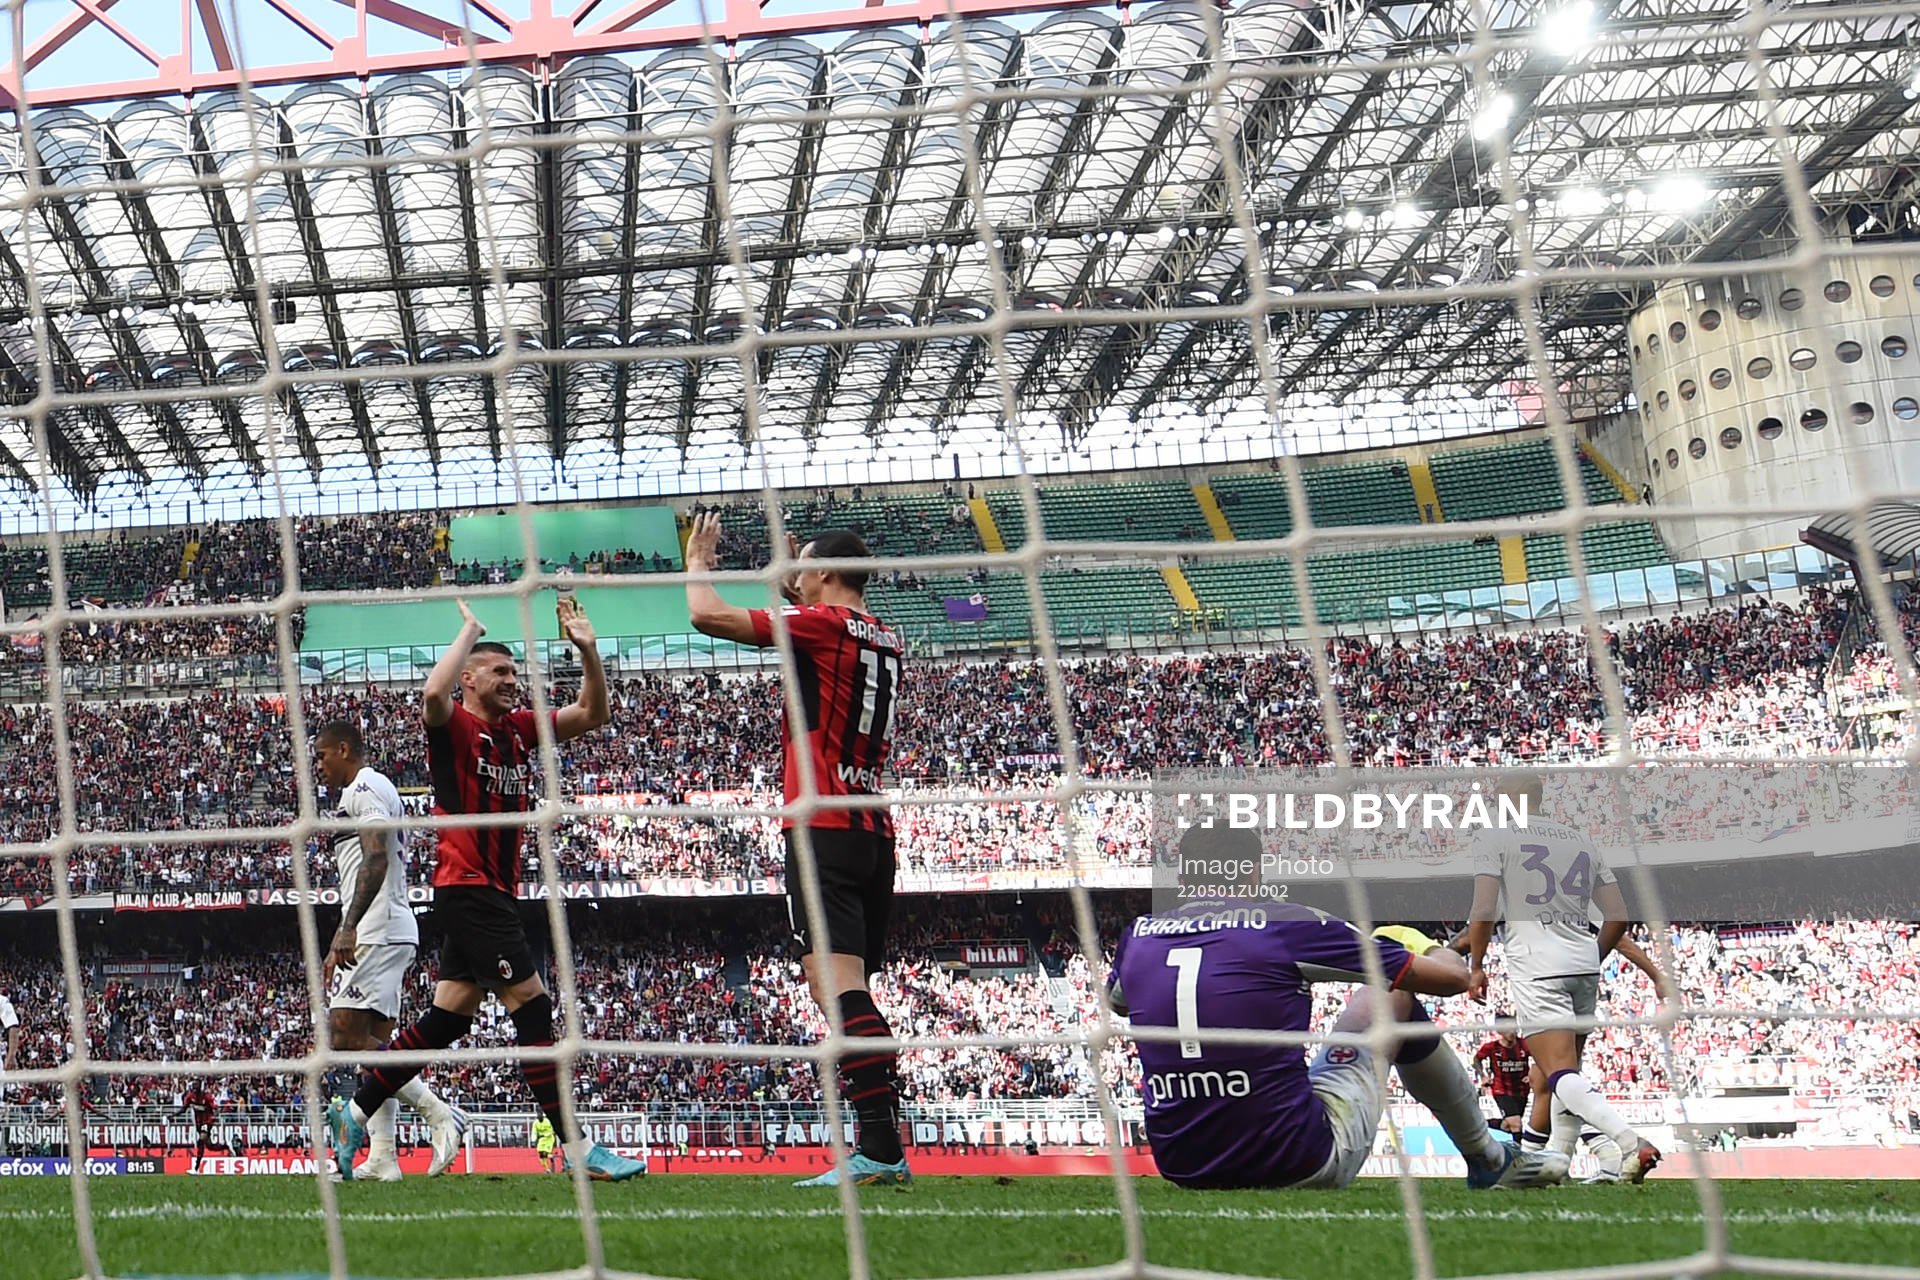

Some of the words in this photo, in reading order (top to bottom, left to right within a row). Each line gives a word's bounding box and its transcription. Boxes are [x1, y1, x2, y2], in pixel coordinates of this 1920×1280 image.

[858, 649, 898, 740] 11
[1006, 753, 1064, 765] COGLIAT
[1520, 844, 1591, 908] 34
[602, 879, 687, 897] MILAN
[694, 879, 769, 896] CLUB
[116, 894, 148, 908] MILAN
[152, 893, 180, 907] CLUB
[195, 892, 242, 906] BOLZANO
[1133, 908, 1267, 937] TERRACCIANO
[966, 947, 1018, 963] MILAN
[332, 973, 342, 997] 8
[1166, 947, 1203, 1058] 1
[1147, 1070, 1251, 1107] prima
[104, 1125, 161, 1145] ITALIANA
[166, 1125, 199, 1145] MILA
[621, 1123, 689, 1144] CALCIO
[766, 1123, 854, 1143] FAMI
[916, 1122, 985, 1143] DAY
[0, 1158, 44, 1176] efox
[54, 1158, 117, 1176] wfox
[127, 1161, 155, 1173] 81:15
[1361, 1157, 1463, 1175] MILANO
